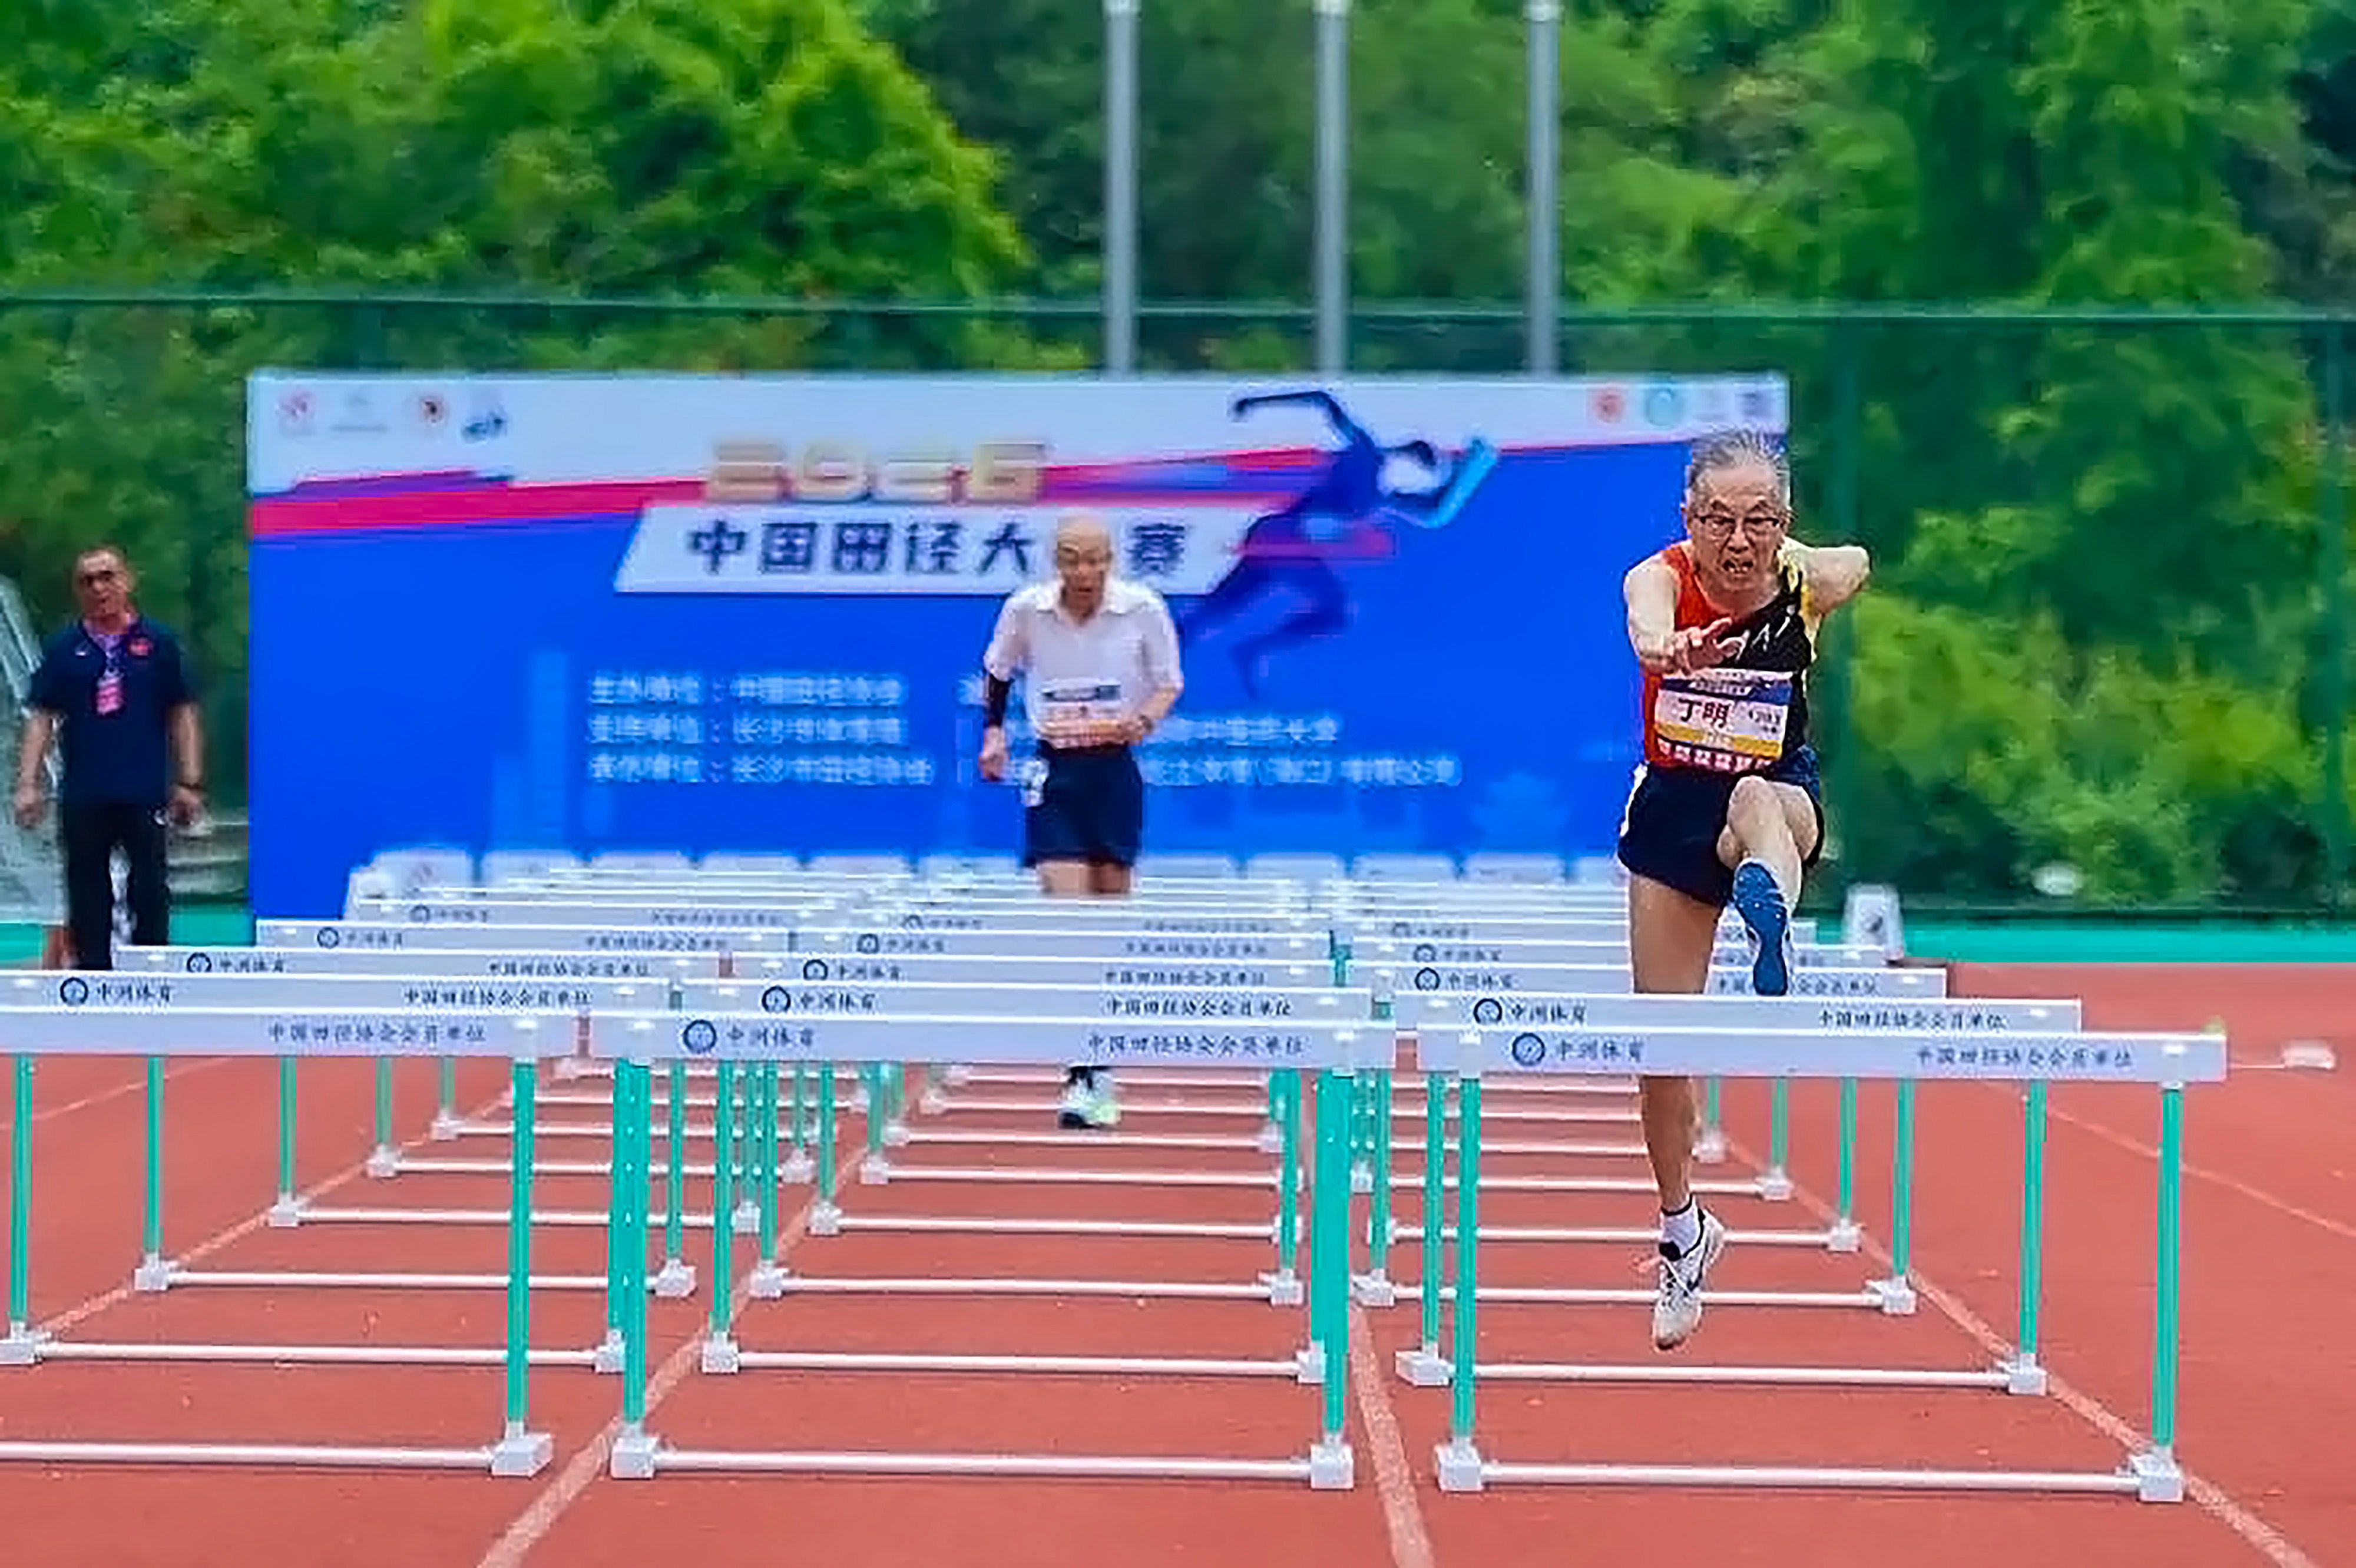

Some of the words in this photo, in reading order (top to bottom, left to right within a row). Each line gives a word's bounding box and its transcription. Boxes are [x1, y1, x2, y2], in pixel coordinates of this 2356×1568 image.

[689, 521, 1186, 575] 中国田径大赛
